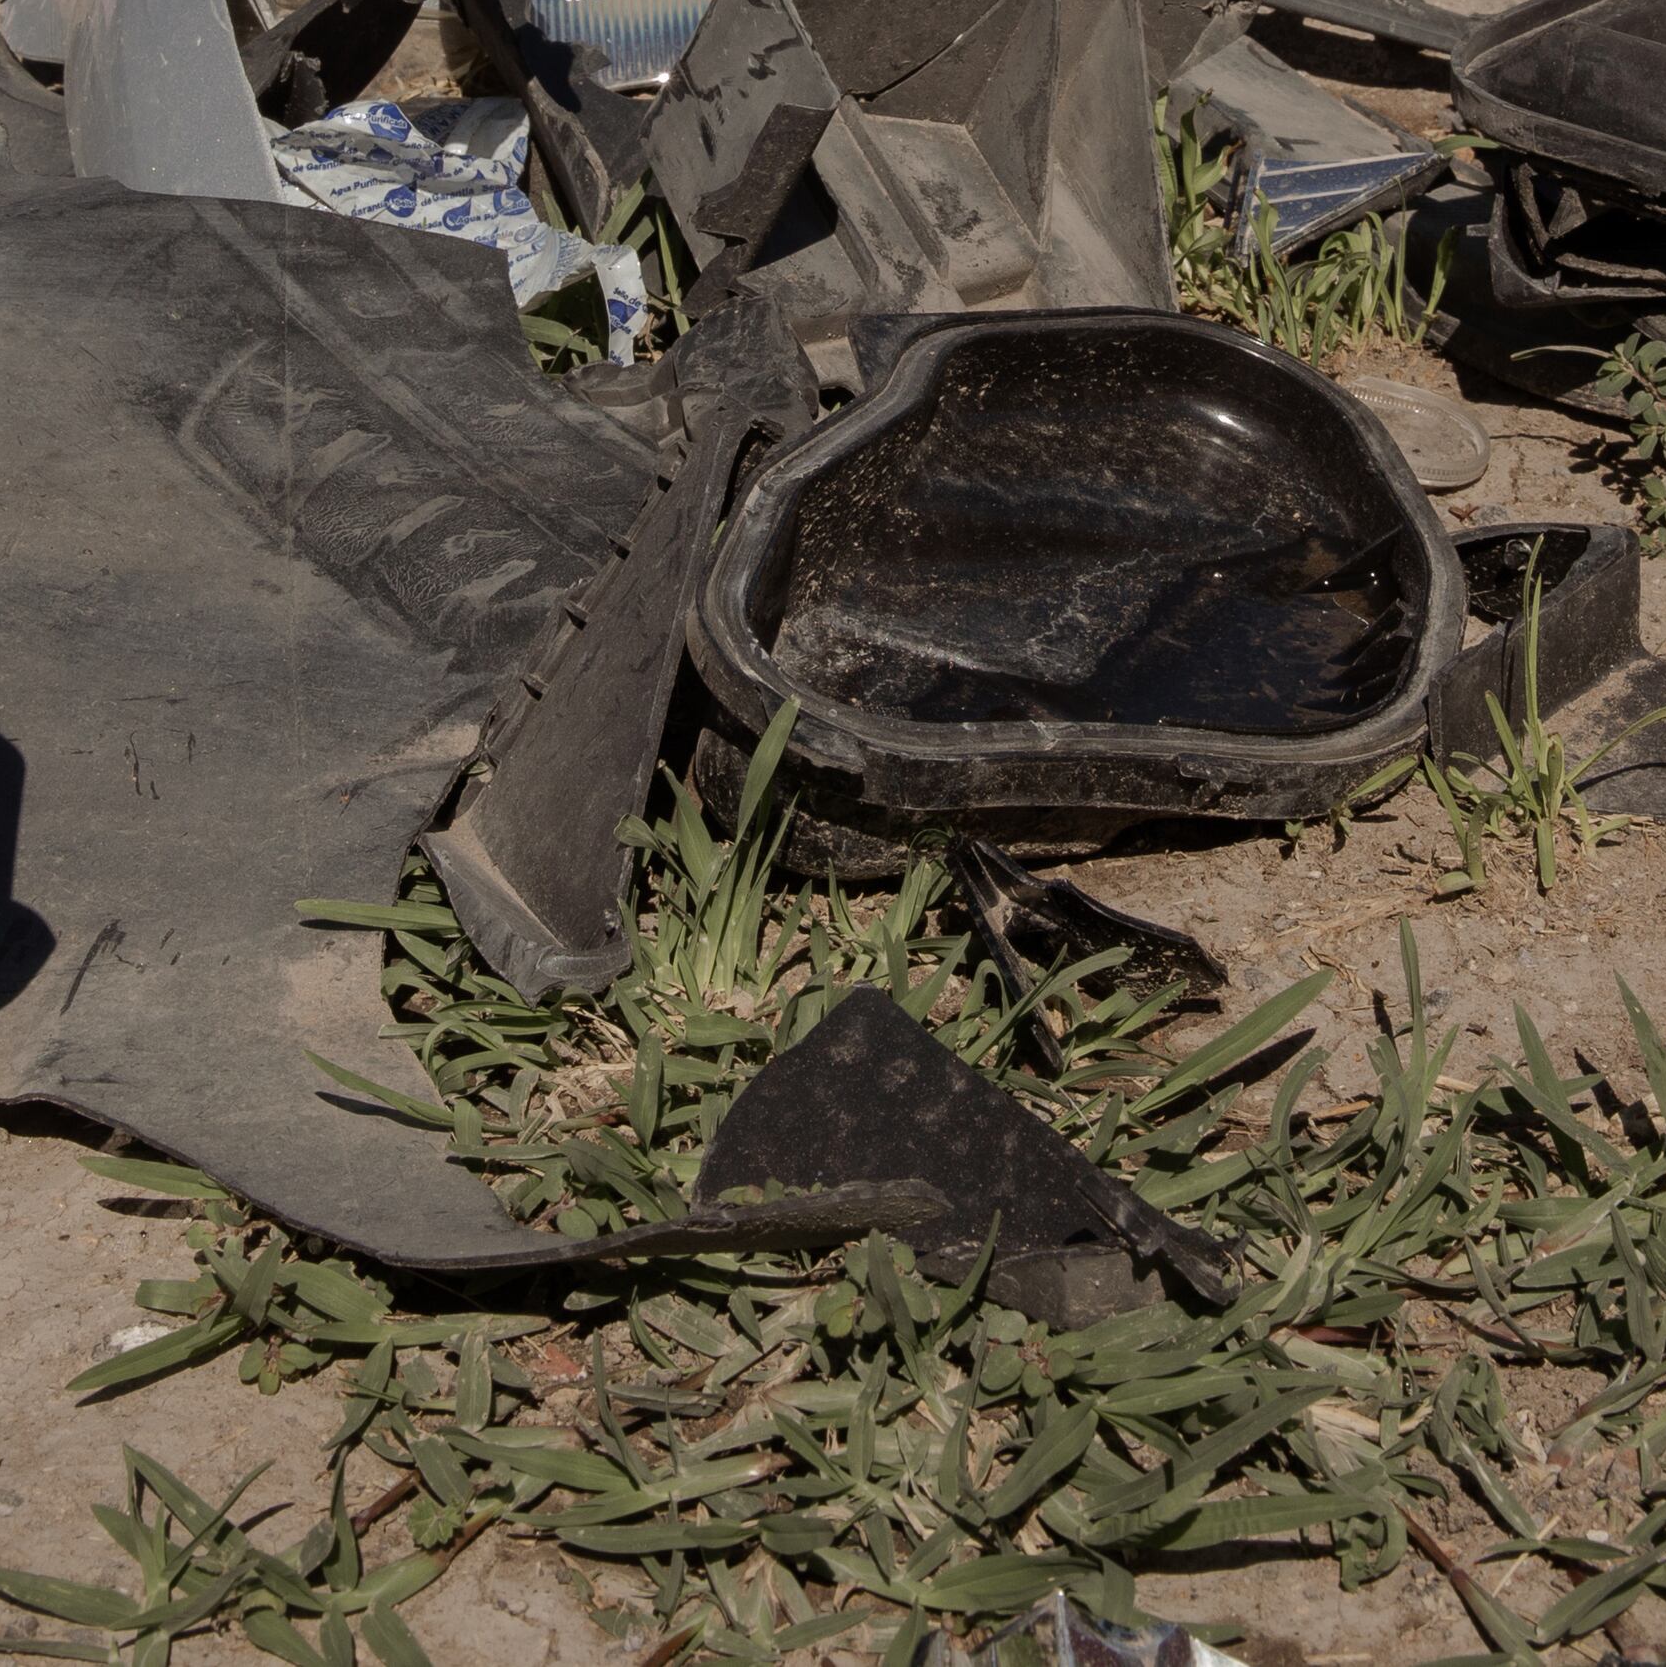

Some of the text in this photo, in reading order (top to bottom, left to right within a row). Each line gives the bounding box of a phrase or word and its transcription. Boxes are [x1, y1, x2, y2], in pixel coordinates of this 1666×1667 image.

[330, 186, 352, 197] Agua
[420, 197, 432, 207] de
[456, 216, 482, 225] Agua
